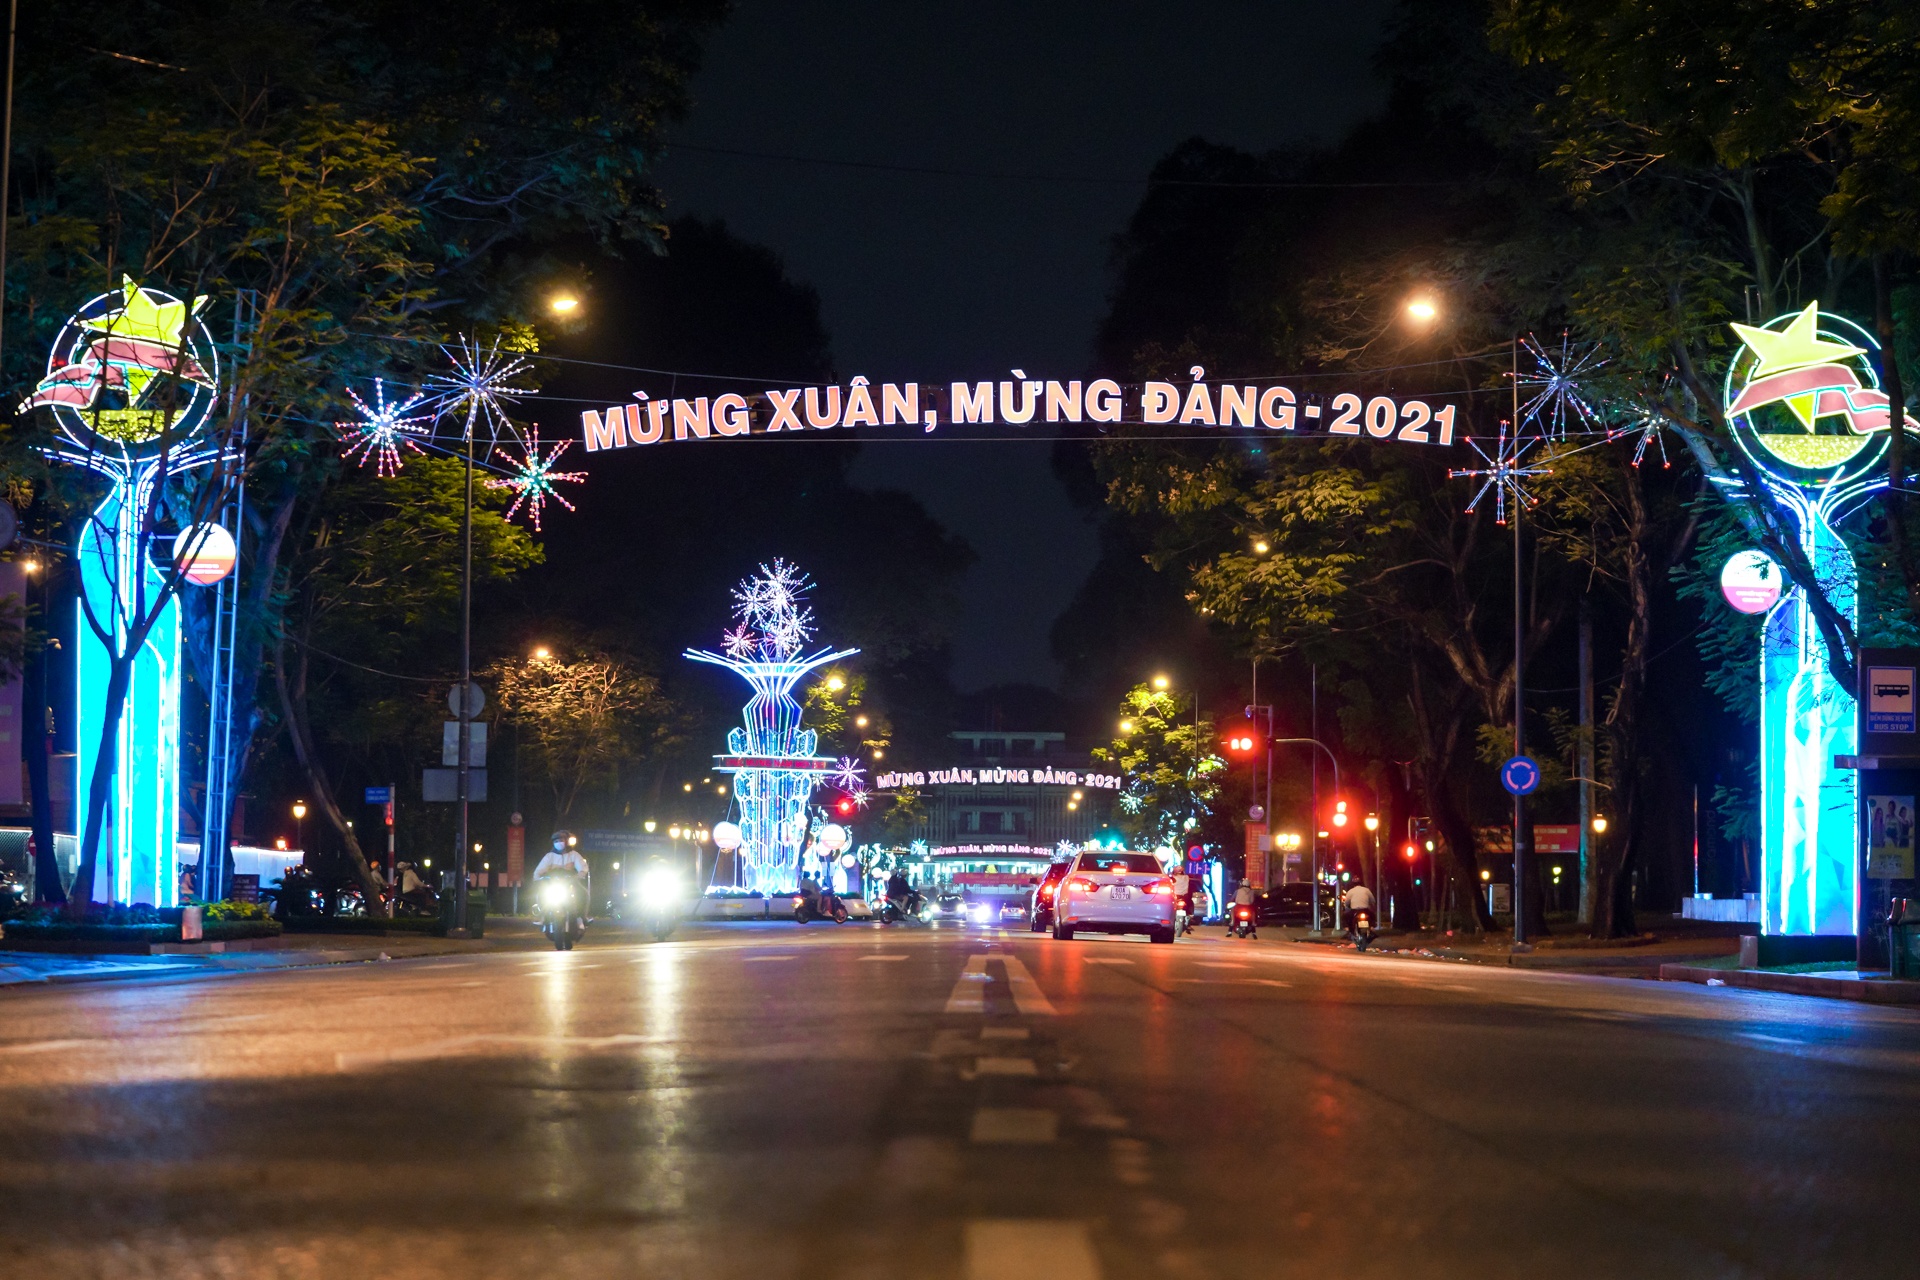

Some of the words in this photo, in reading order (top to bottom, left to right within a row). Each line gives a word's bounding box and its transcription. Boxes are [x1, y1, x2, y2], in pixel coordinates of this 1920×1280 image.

[580, 391, 750, 452] MỪNG
[766, 375, 937, 433] XUÂN,
[951, 368, 1123, 424] MỪNG
[1141, 365, 1297, 430] ĐẢNG
[1891, 723, 1909, 731] STOP
[876, 770, 925, 789] MỪNG
[928, 766, 977, 785] XUÂN,
[979, 766, 1029, 784] MỪNG
[1033, 765, 1077, 785] ĐẢNG
